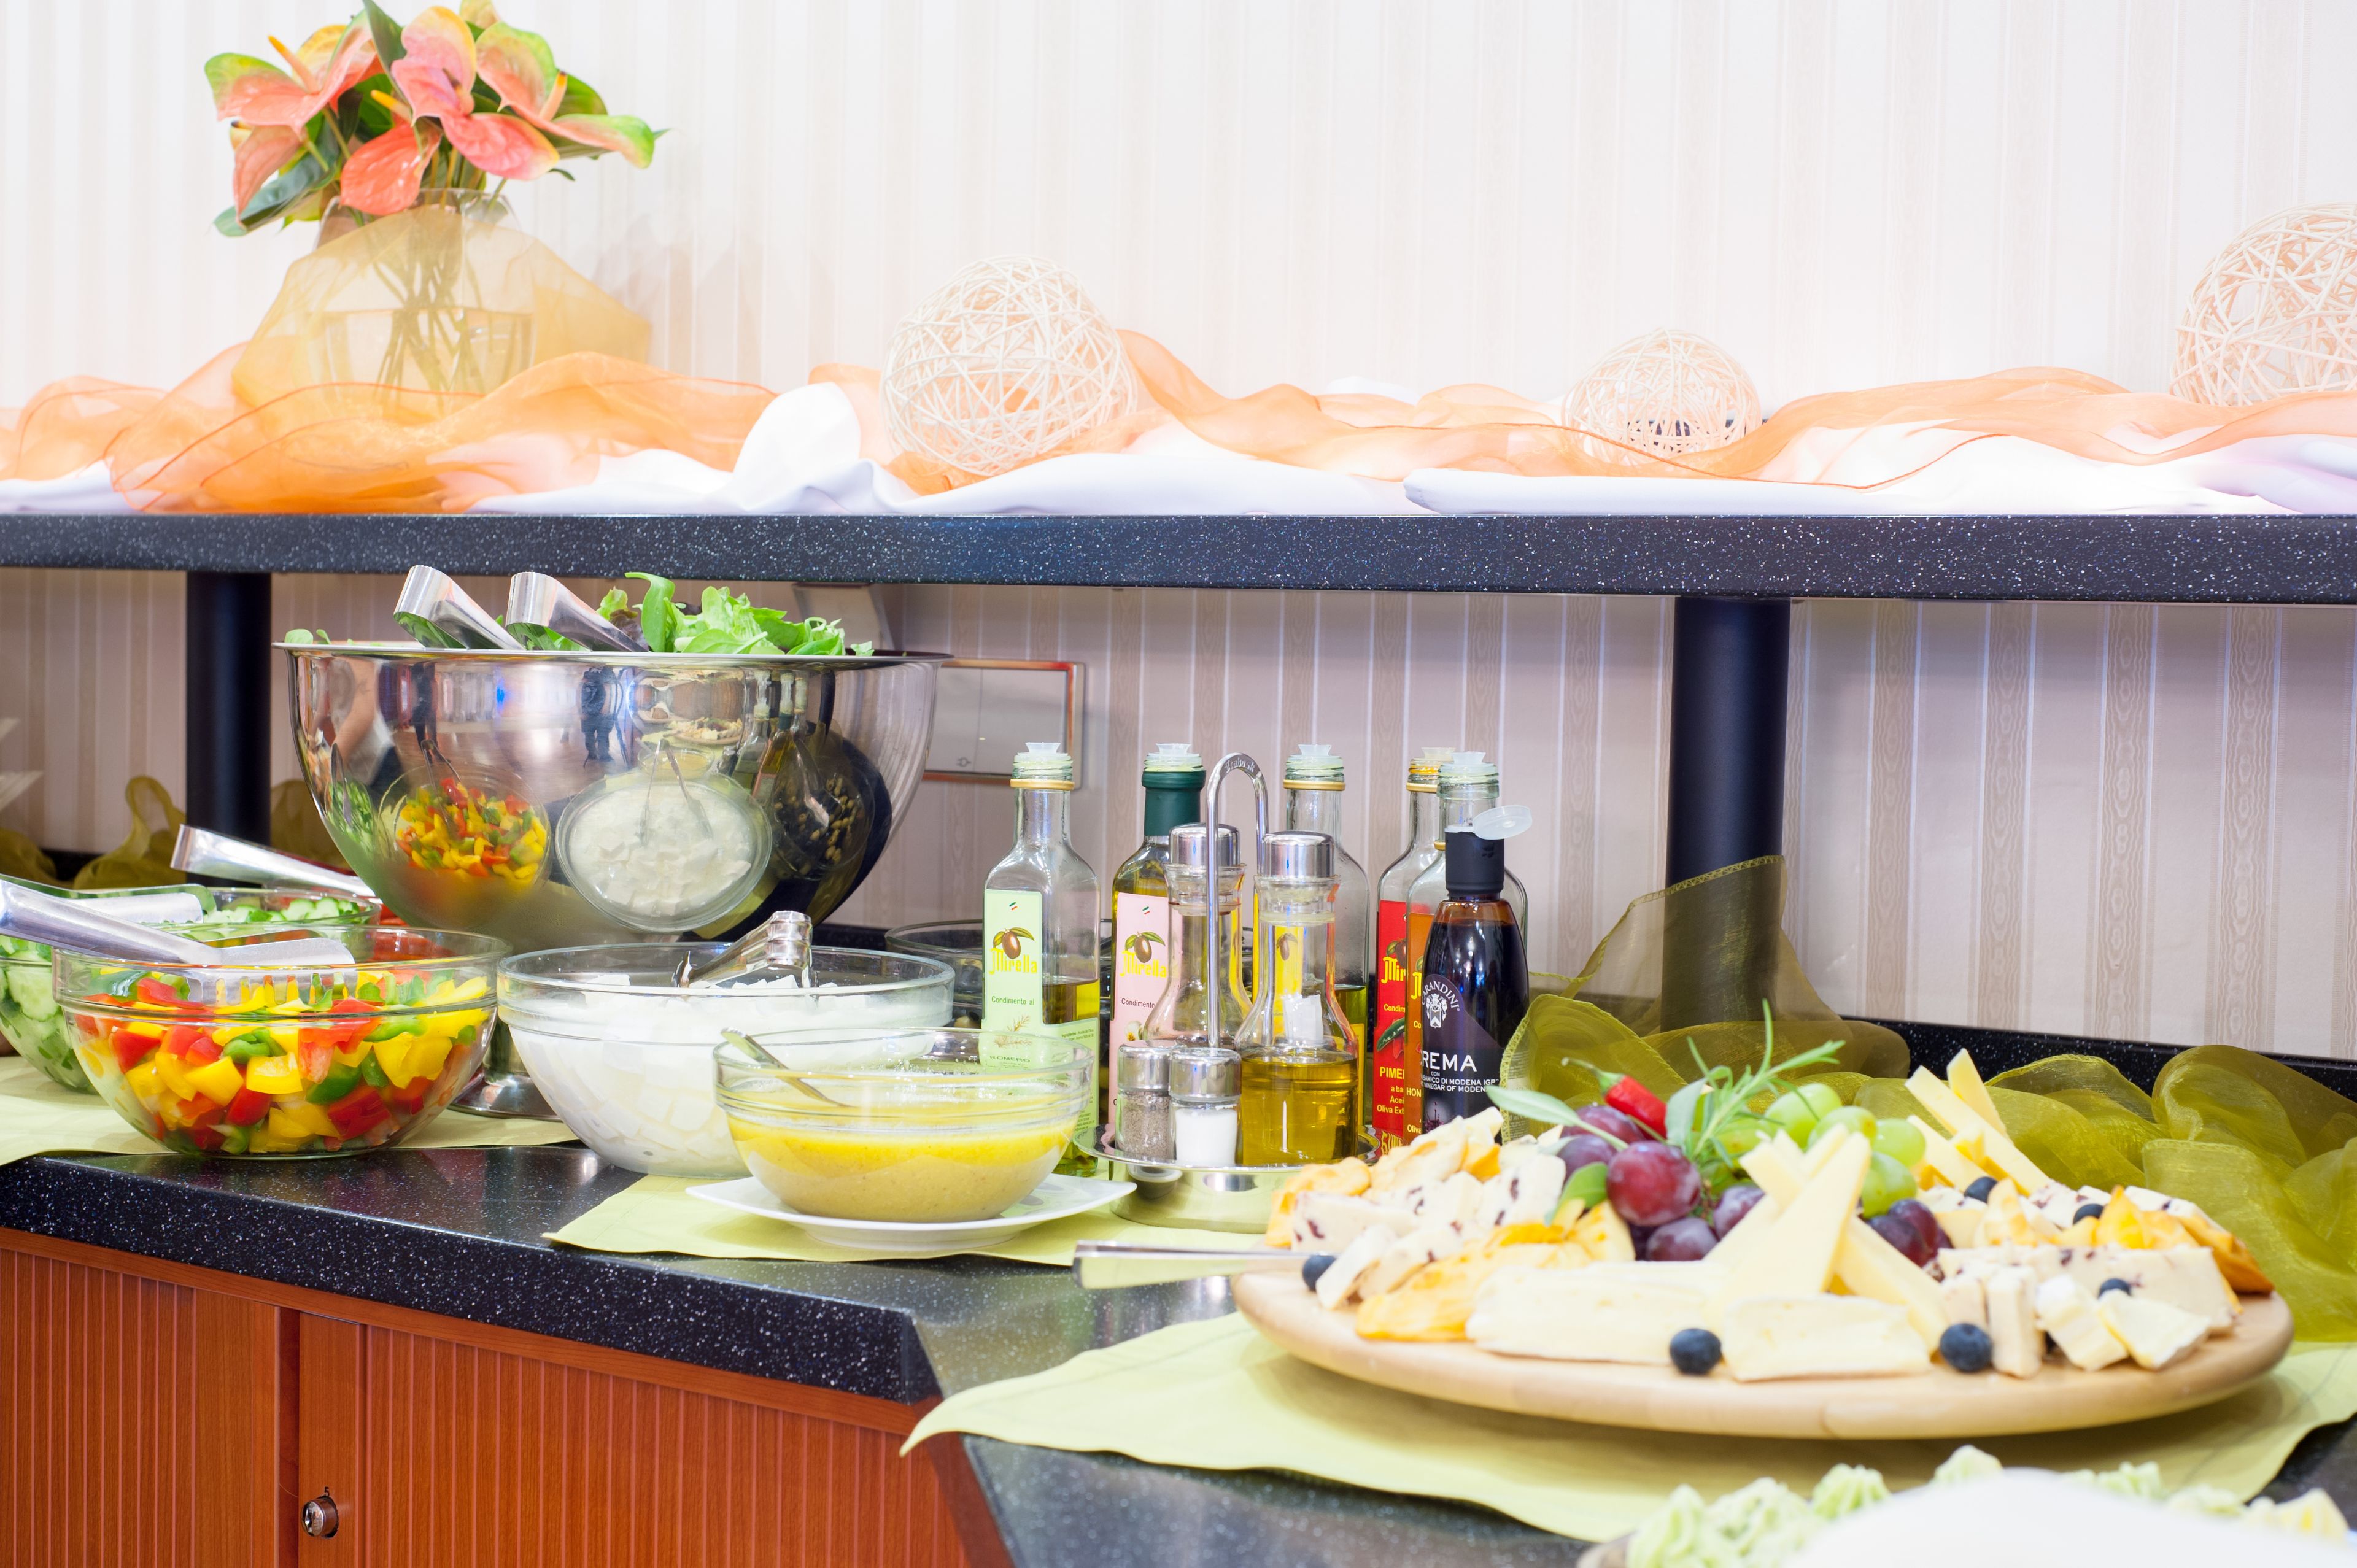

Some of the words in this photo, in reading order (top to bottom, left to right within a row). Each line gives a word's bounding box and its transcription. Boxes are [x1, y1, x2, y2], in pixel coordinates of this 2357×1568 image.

[989, 948, 1037, 975] Mirella
[1119, 950, 1167, 977] Mirella
[991, 996, 1026, 1005] Condimento
[1420, 1050, 1477, 1072] REMA
[1379, 1066, 1404, 1079] PIME
[1377, 1104, 1393, 1114] Oliva
